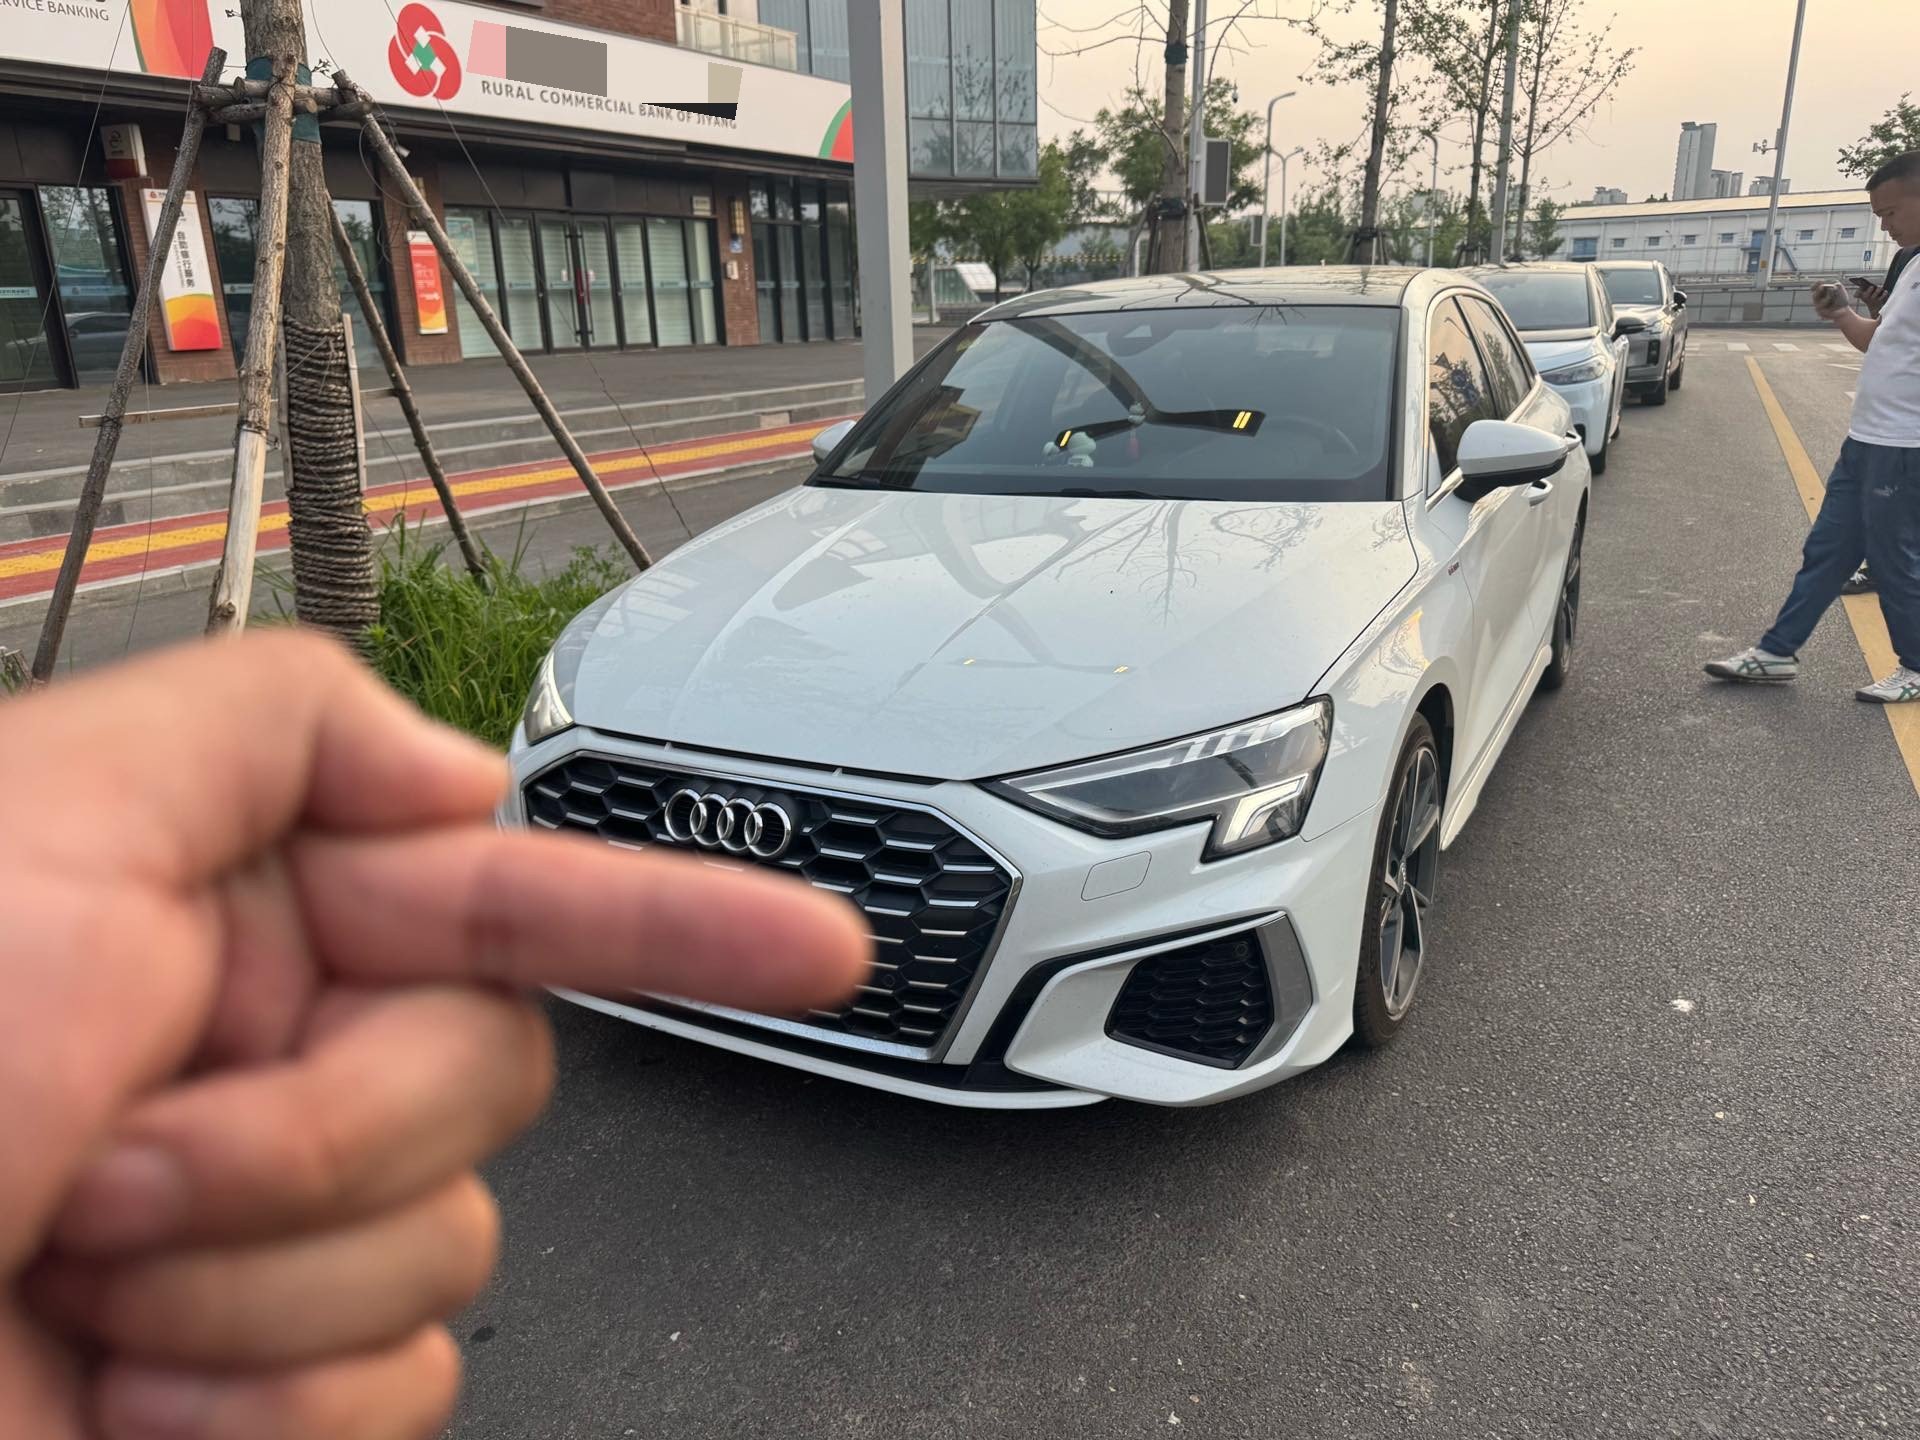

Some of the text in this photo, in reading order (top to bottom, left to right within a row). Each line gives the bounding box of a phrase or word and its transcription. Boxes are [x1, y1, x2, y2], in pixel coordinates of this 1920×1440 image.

[47, 1, 109, 21] BANKING
[481, 80, 535, 101] RURAL
[539, 89, 635, 116] COMMERCIAL
[639, 102, 673, 120] BANK
[676, 110, 693, 123] OF
